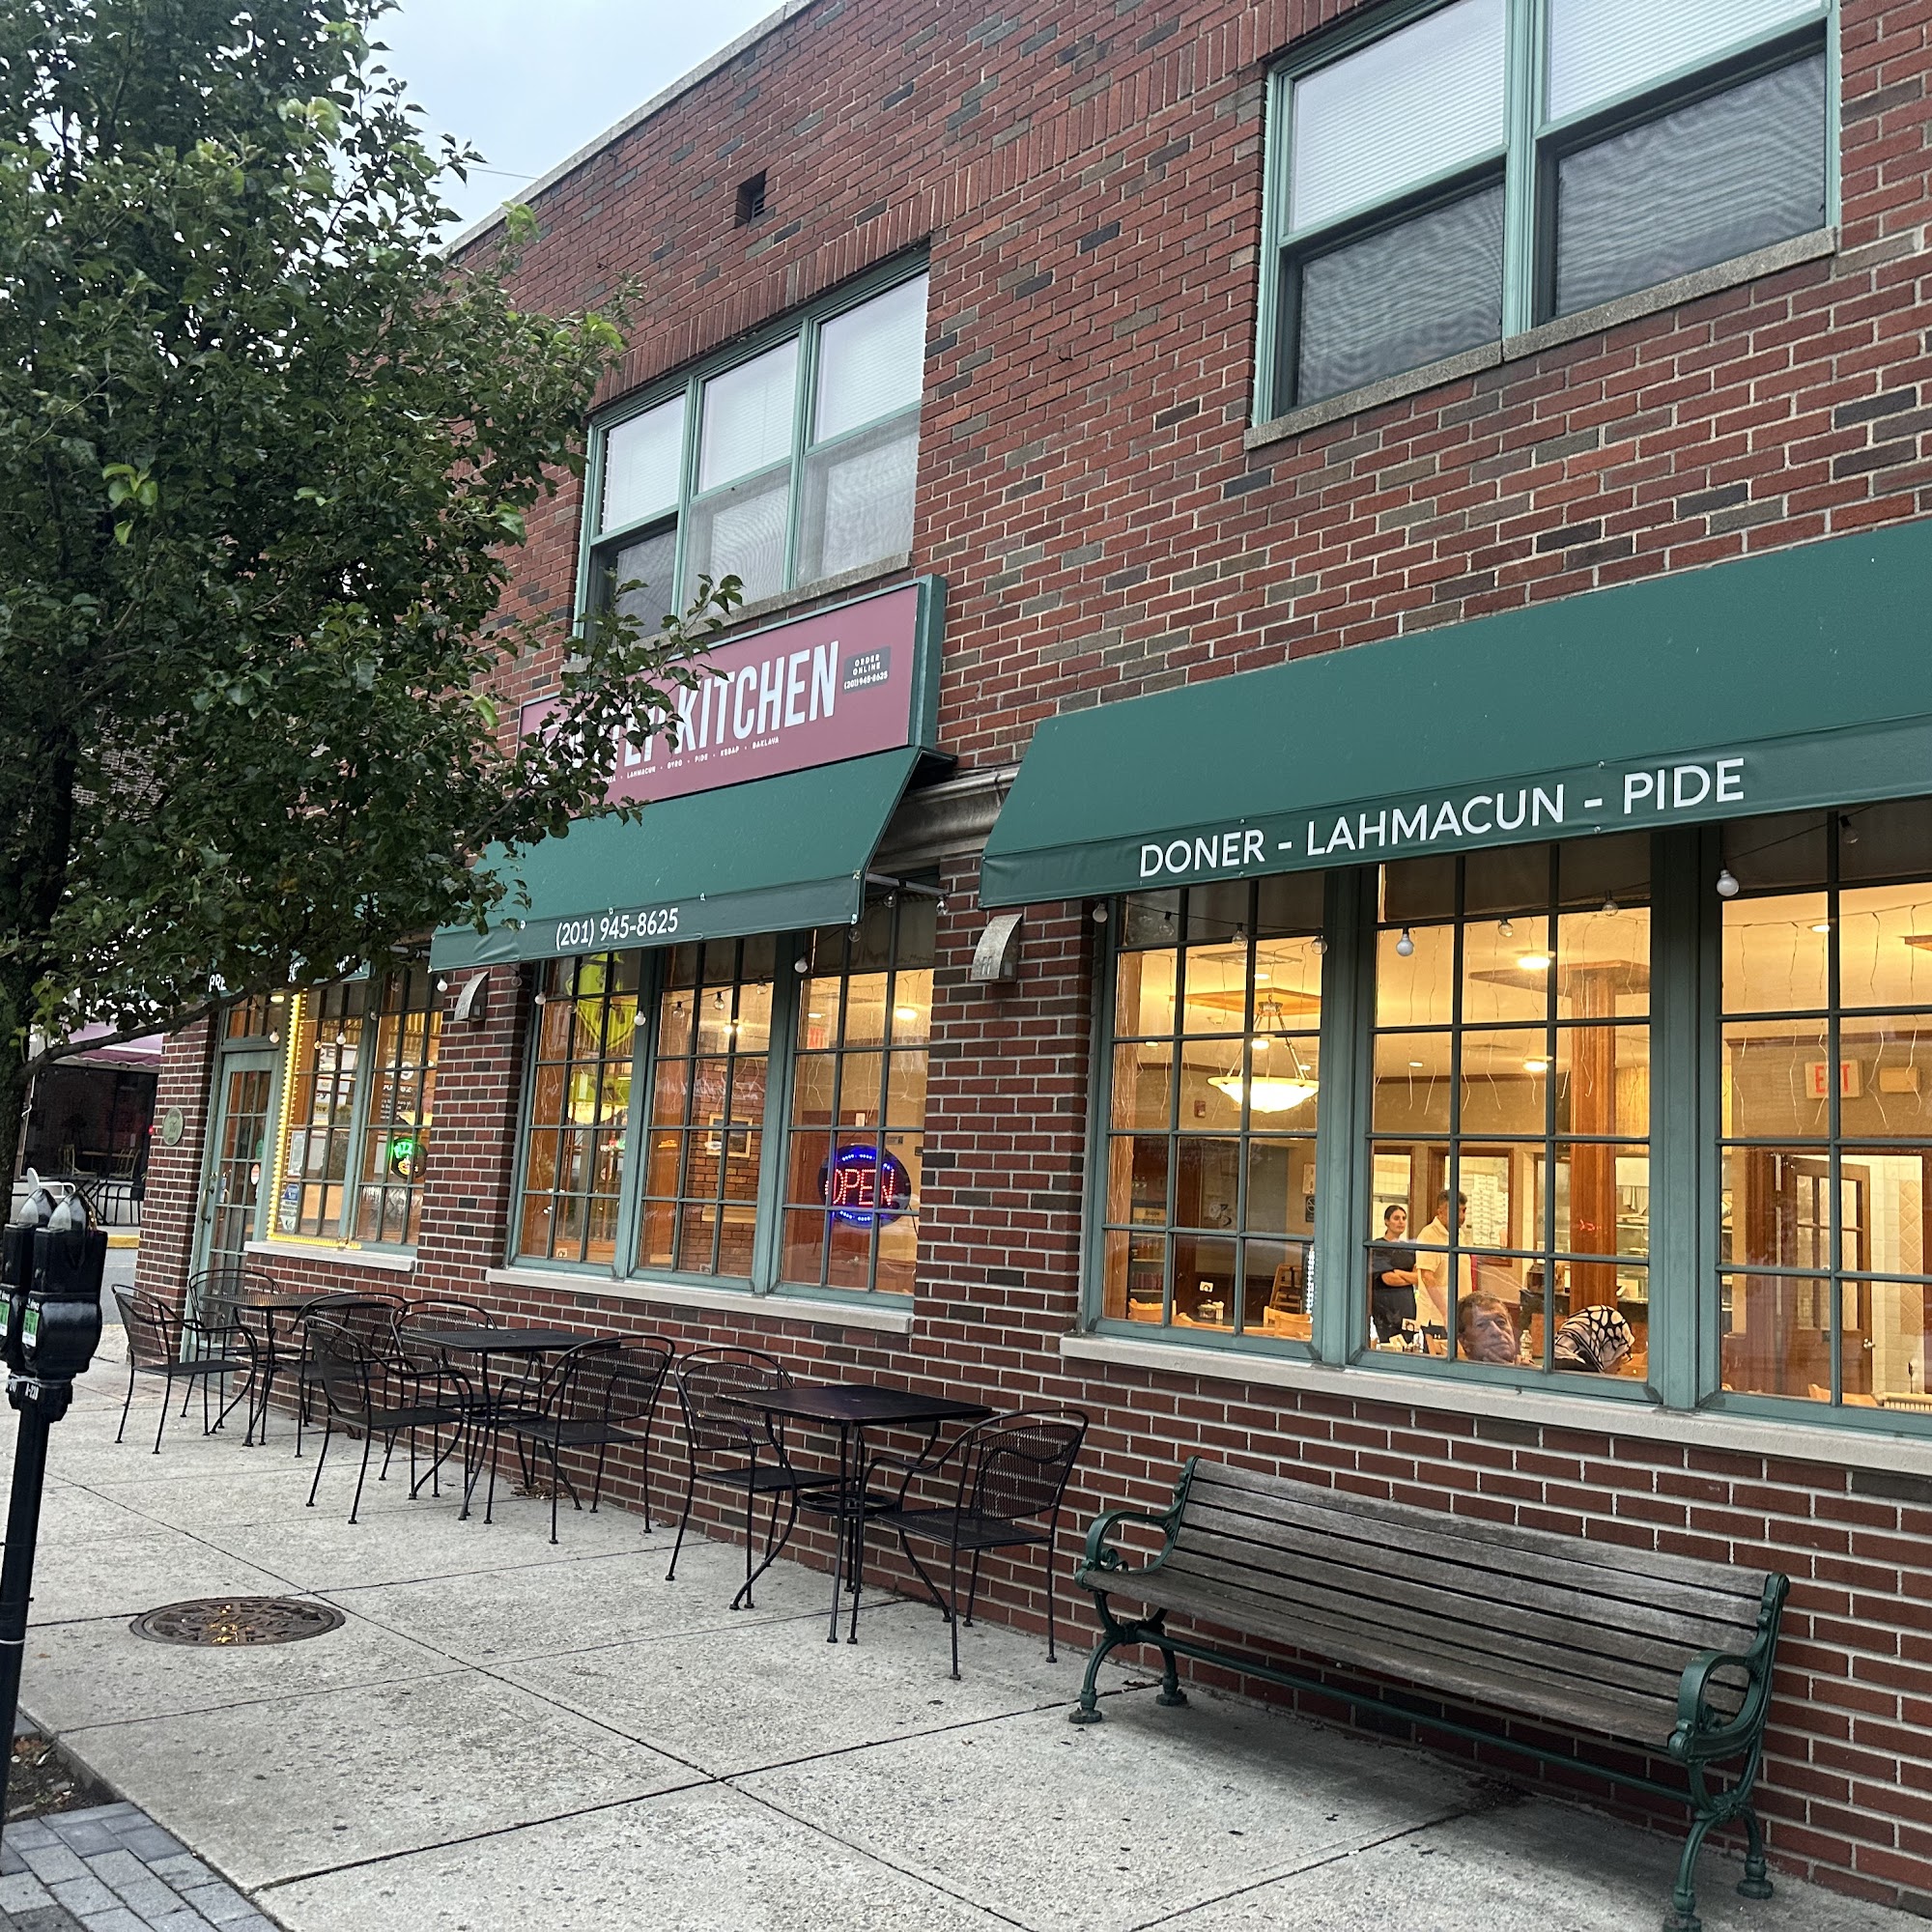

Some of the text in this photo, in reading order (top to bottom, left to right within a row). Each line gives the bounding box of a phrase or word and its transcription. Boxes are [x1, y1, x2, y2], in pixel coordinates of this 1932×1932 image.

[852, 661, 881, 676] ONLINE
[854, 653, 880, 668] ORDER
[674, 640, 838, 754] KITCHEN
[695, 753, 708, 763] PIDE
[720, 745, 740, 757] KEBAP
[752, 736, 780, 750] BAKLAVA
[1140, 828, 1265, 878] DONER
[1306, 783, 1564, 856] LAHMACUN
[1623, 757, 1744, 814] PIDE
[555, 907, 679, 952] (201) 945-8625
[824, 1168, 895, 1206] OPEN
